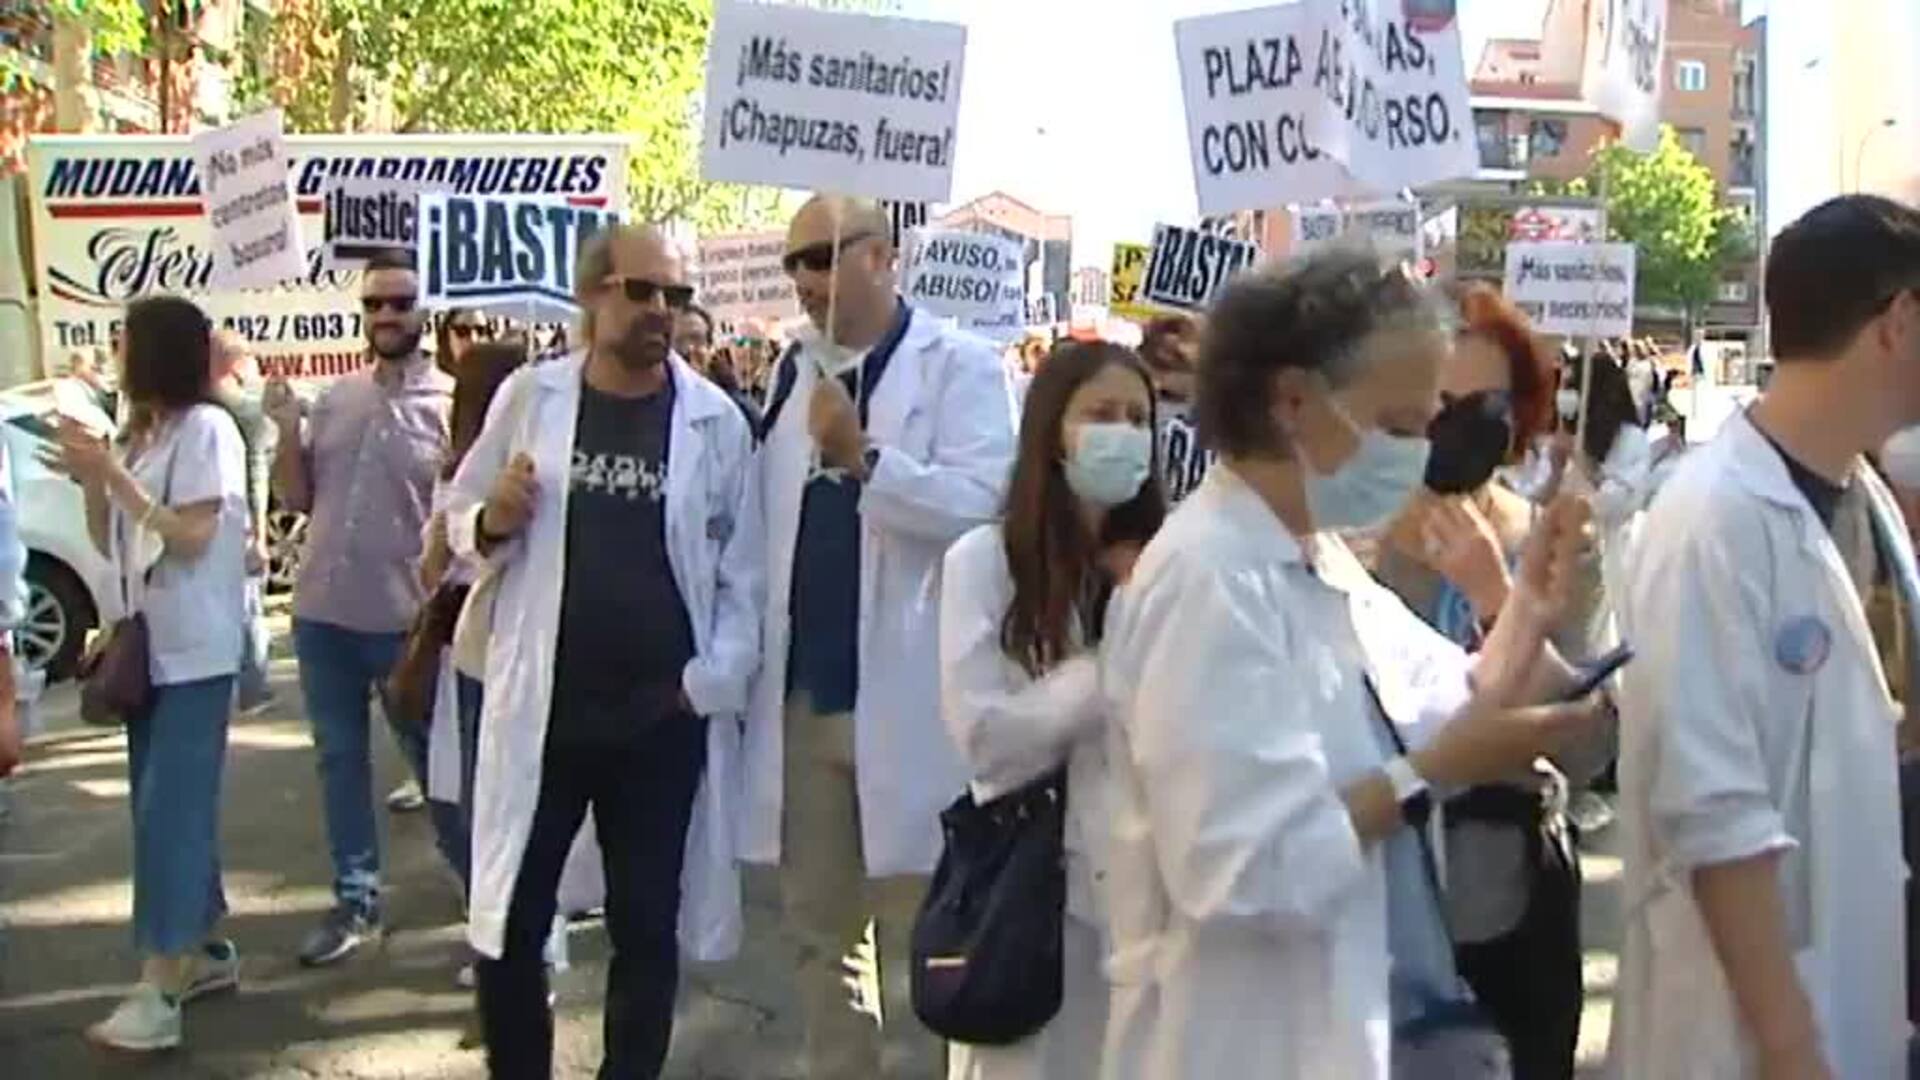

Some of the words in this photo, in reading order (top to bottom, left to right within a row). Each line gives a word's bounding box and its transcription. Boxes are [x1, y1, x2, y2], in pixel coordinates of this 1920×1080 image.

[736, 37, 802, 86] ¡Más
[808, 51, 952, 102] sanitarios!
[1203, 35, 1302, 97] PLAZA
[719, 98, 865, 164] ¡Chapuzas,
[873, 115, 954, 166] fuera!
[1203, 120, 1269, 174] CON
[44, 158, 204, 199] MUDAN
[427, 197, 621, 297] ¡BAST
[914, 238, 1003, 273] ¡AYUSO,
[1143, 225, 1257, 300] ¡BAST
[912, 273, 1001, 304] ABUSO!
[293, 314, 344, 341] 603
